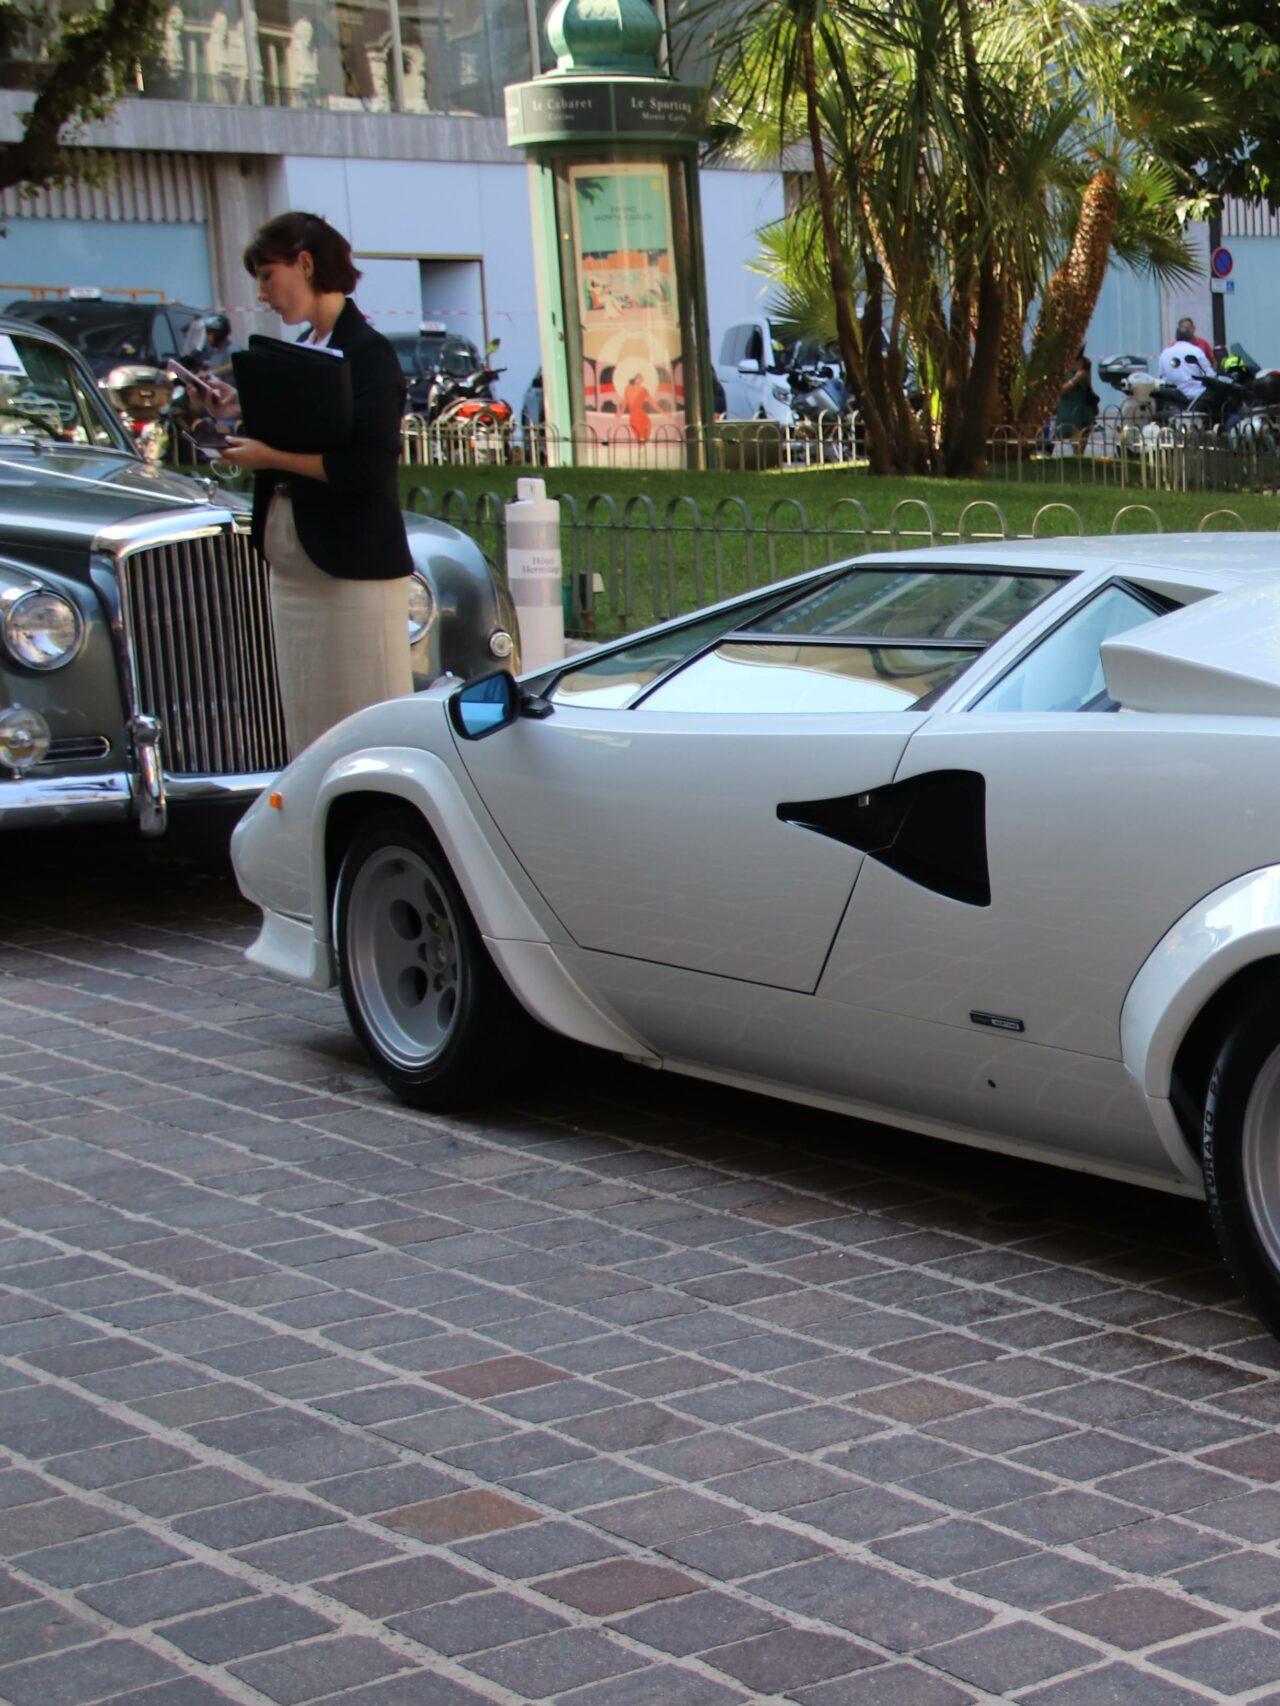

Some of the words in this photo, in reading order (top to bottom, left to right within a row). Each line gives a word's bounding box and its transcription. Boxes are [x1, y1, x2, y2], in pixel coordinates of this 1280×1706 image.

[532, 100, 543, 111] Le
[547, 96, 593, 110] Cabaret
[631, 97, 644, 109] Le
[650, 98, 692, 113] Sporting
